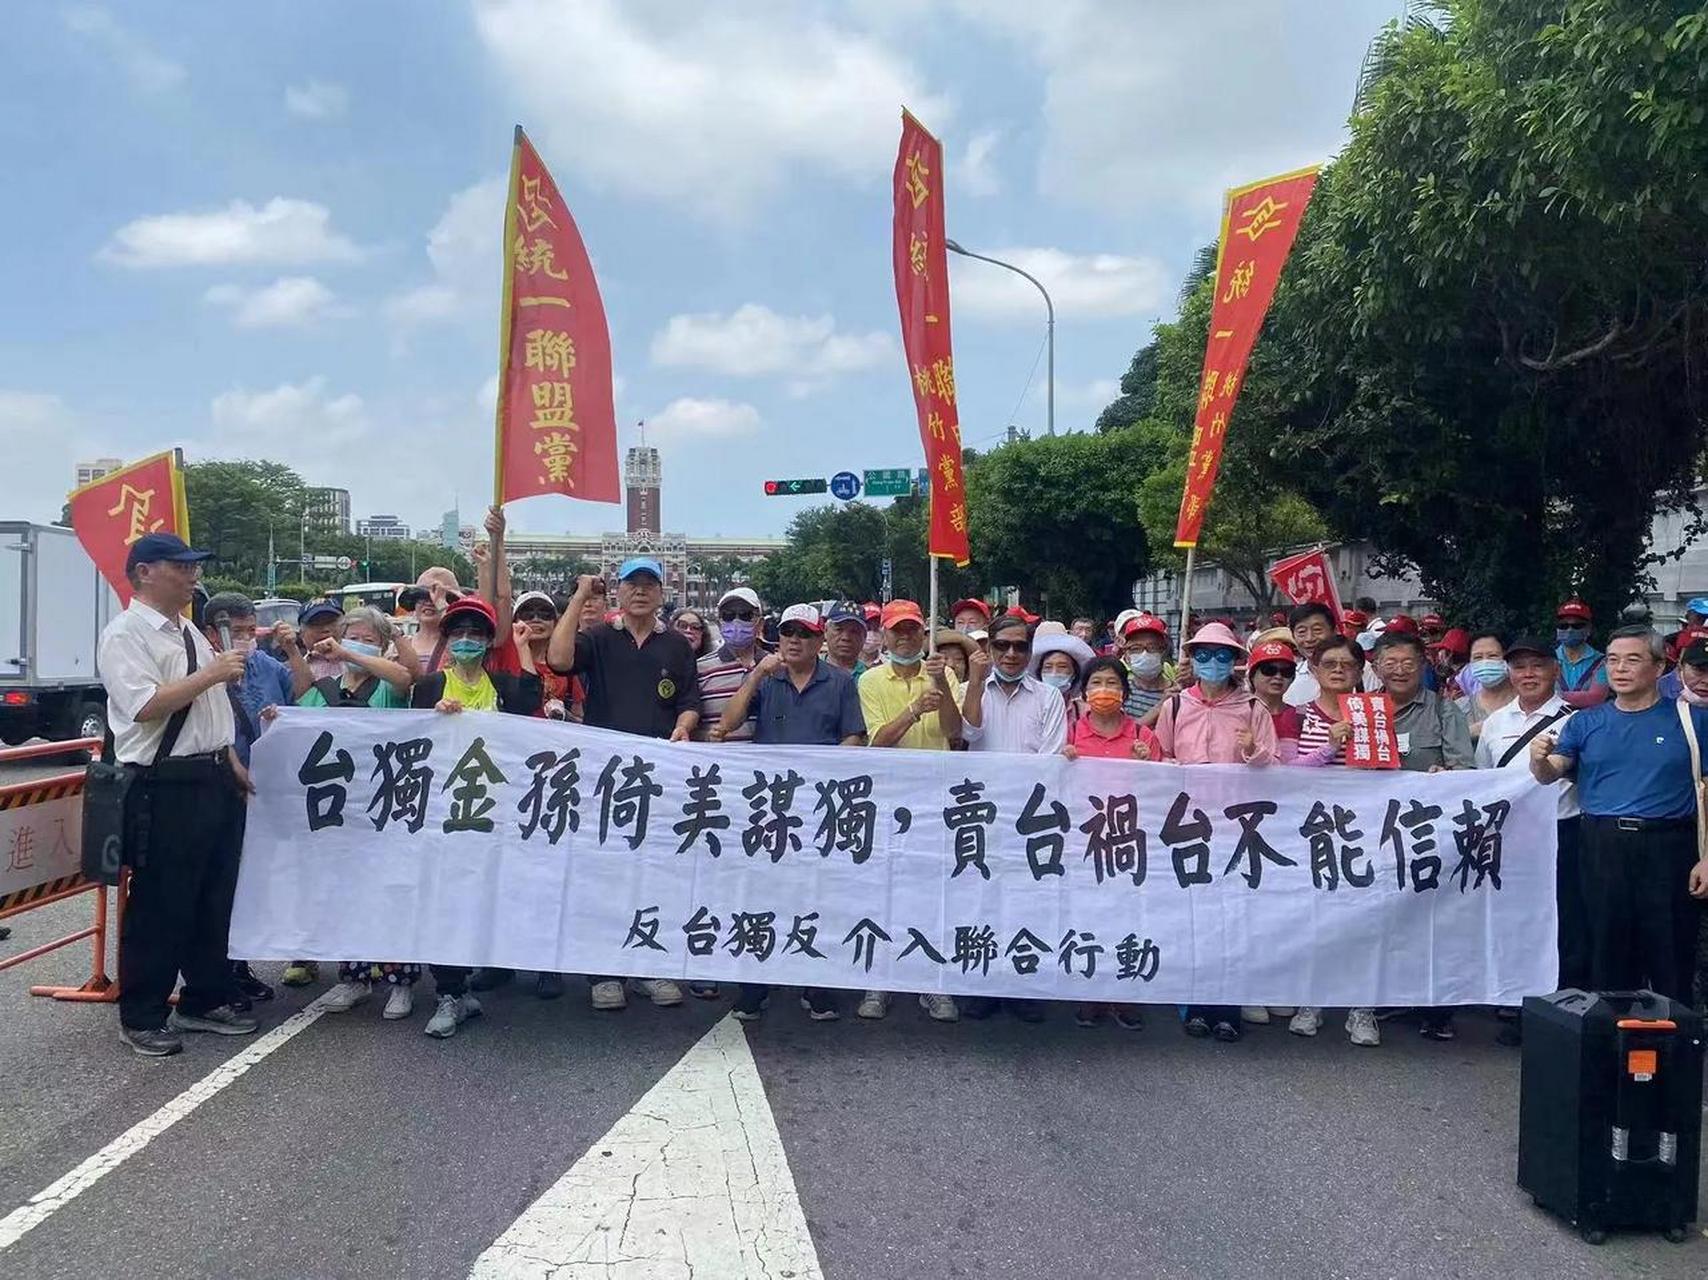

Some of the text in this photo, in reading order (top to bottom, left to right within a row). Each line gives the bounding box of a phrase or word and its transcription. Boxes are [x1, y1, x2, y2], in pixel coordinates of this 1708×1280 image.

[512, 234, 580, 490] 統一聯盟黨
[6, 817, 73, 872] 進入
[621, 905, 1161, 983] 反台獨反介入聯合行動
